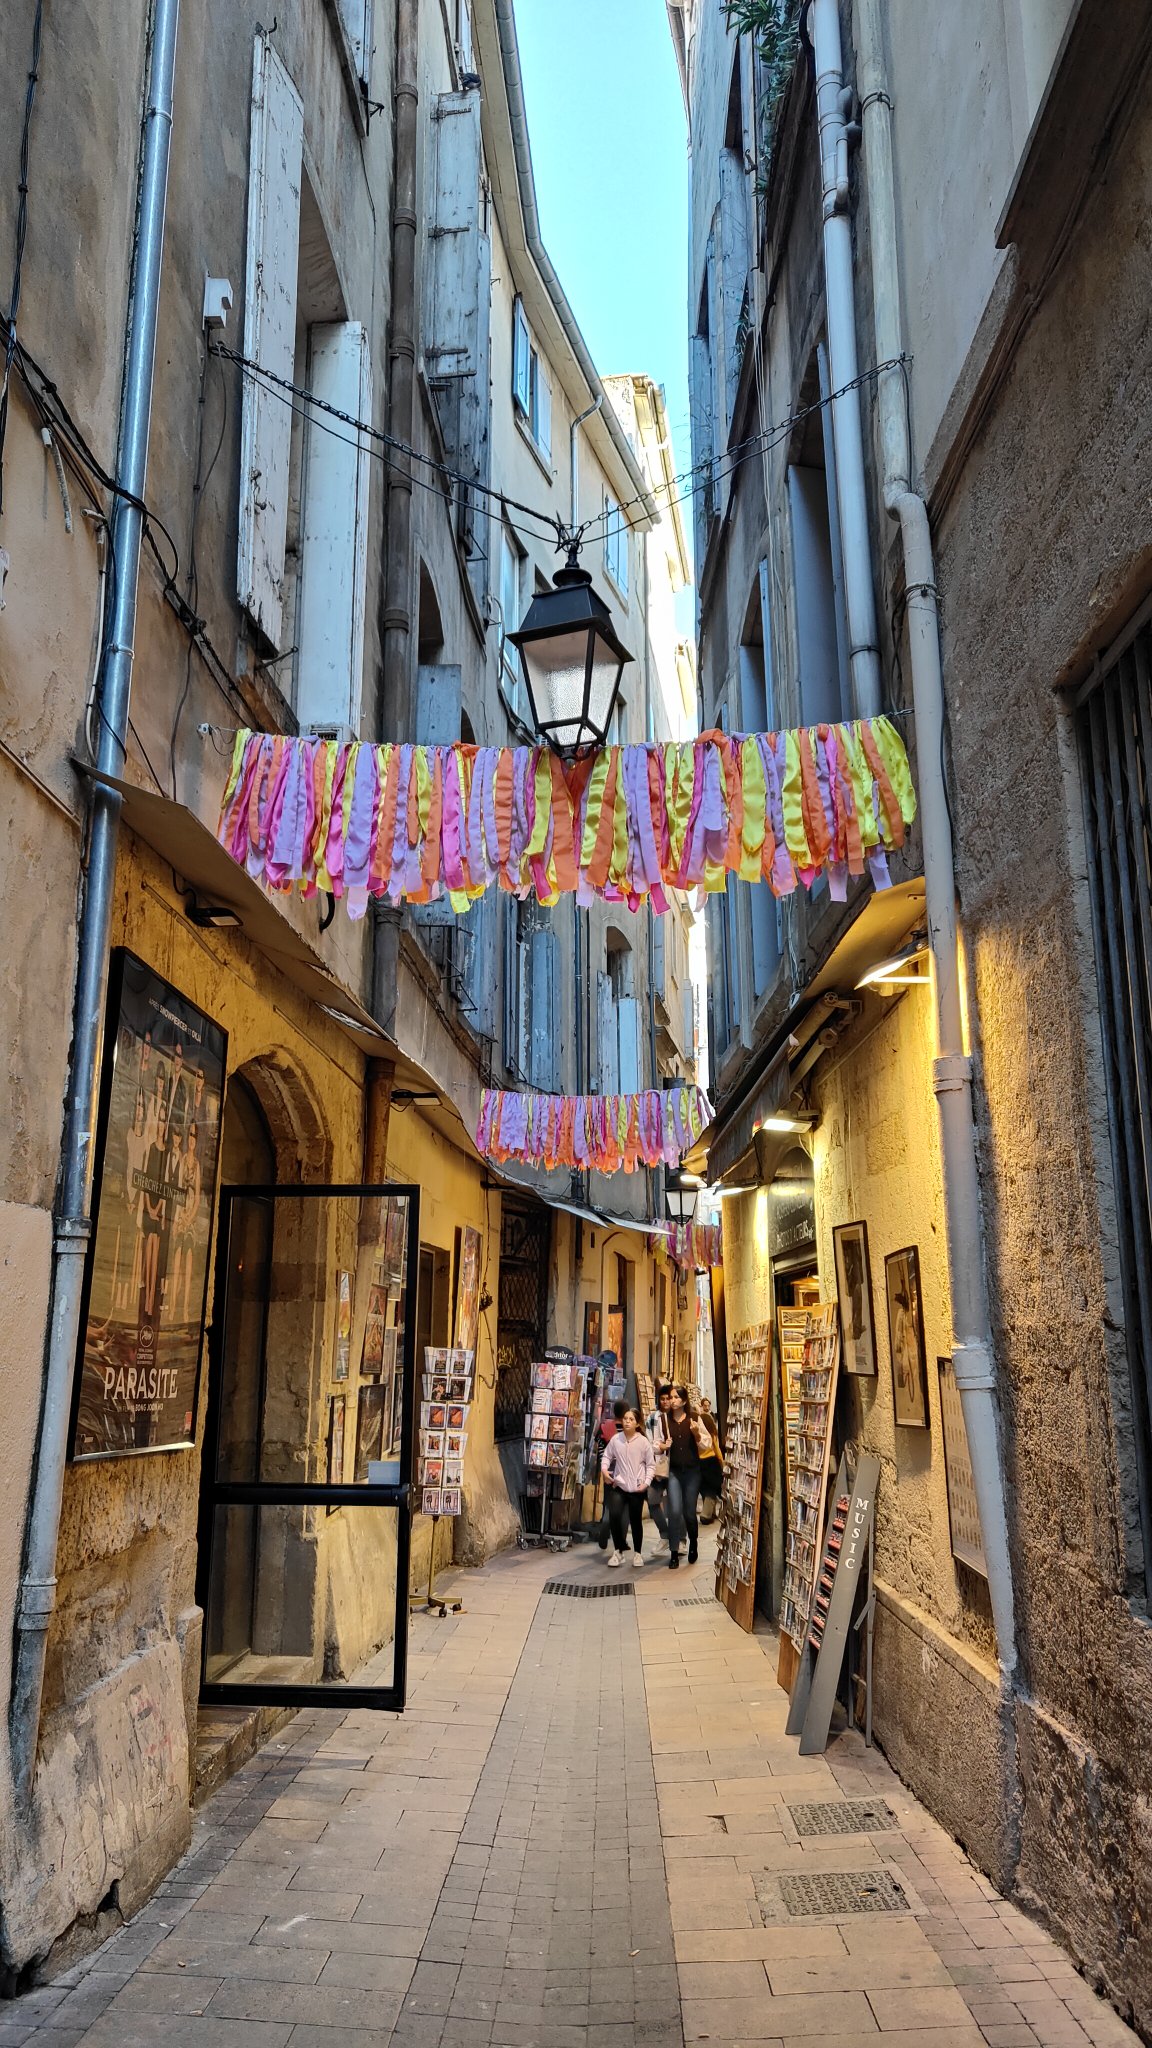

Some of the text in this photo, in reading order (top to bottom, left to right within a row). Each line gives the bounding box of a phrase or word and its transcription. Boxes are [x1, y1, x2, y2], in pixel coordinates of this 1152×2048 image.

[133, 1172, 162, 1195] CHERCHEZ
[104, 1366, 178, 1400] PARASITE
[135, 1403, 147, 1412] BONG
[845, 1497, 869, 1569] MUSIC
